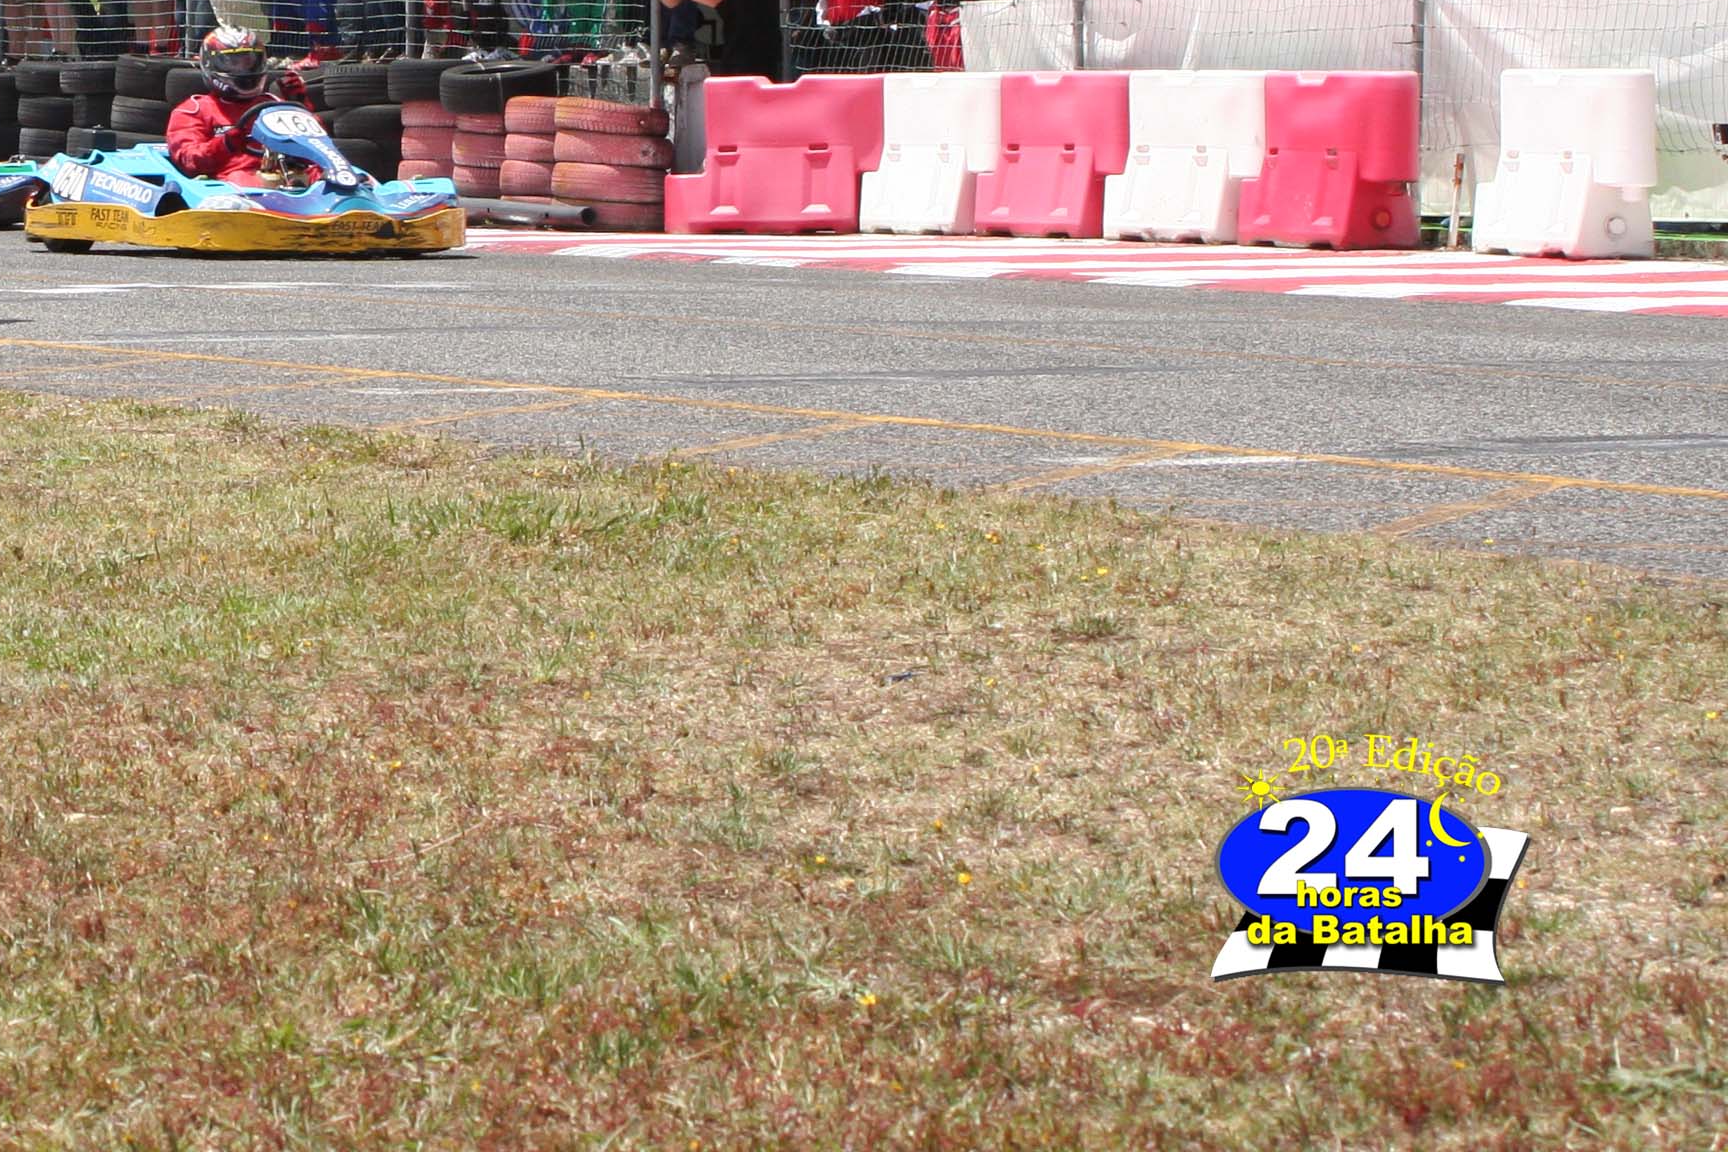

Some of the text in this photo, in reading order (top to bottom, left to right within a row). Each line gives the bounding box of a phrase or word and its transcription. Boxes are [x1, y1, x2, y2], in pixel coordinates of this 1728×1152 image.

[276, 114, 323, 135] 160
[90, 170, 153, 204] TECNIROLO
[91, 207, 111, 221] FAST
